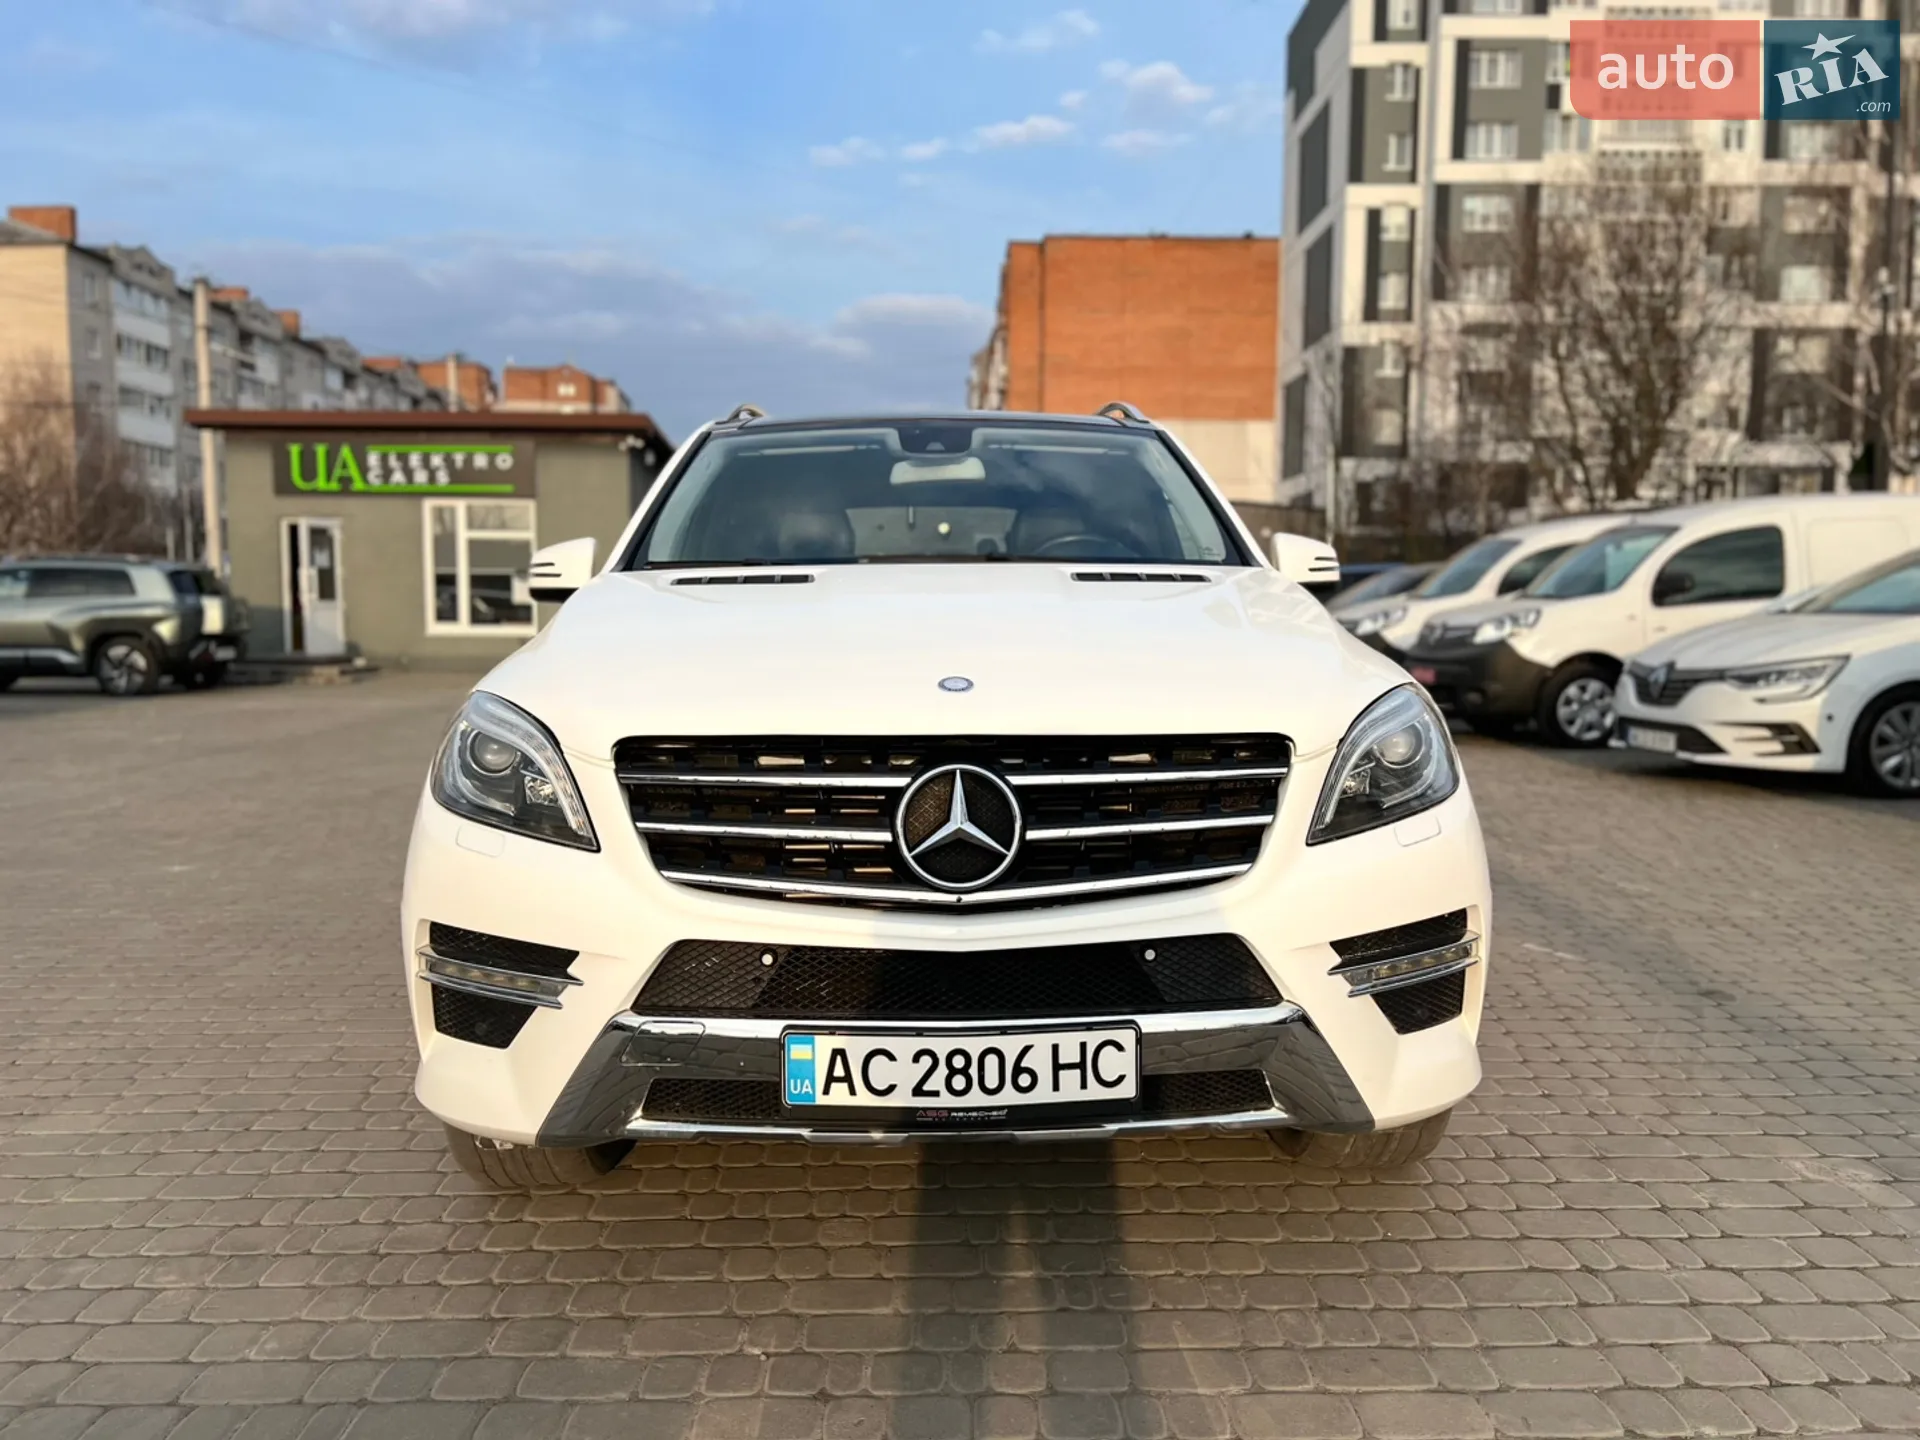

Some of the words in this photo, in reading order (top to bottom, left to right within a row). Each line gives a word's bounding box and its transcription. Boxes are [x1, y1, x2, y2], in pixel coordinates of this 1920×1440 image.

[288, 443, 366, 491] UA
[366, 452, 514, 470] ELEKTRO
[366, 468, 450, 486] CARS
[822, 1047, 898, 1097] AC
[911, 1045, 1038, 1097] 2806
[1051, 1039, 1127, 1092] HC
[790, 1078, 813, 1094] UA
